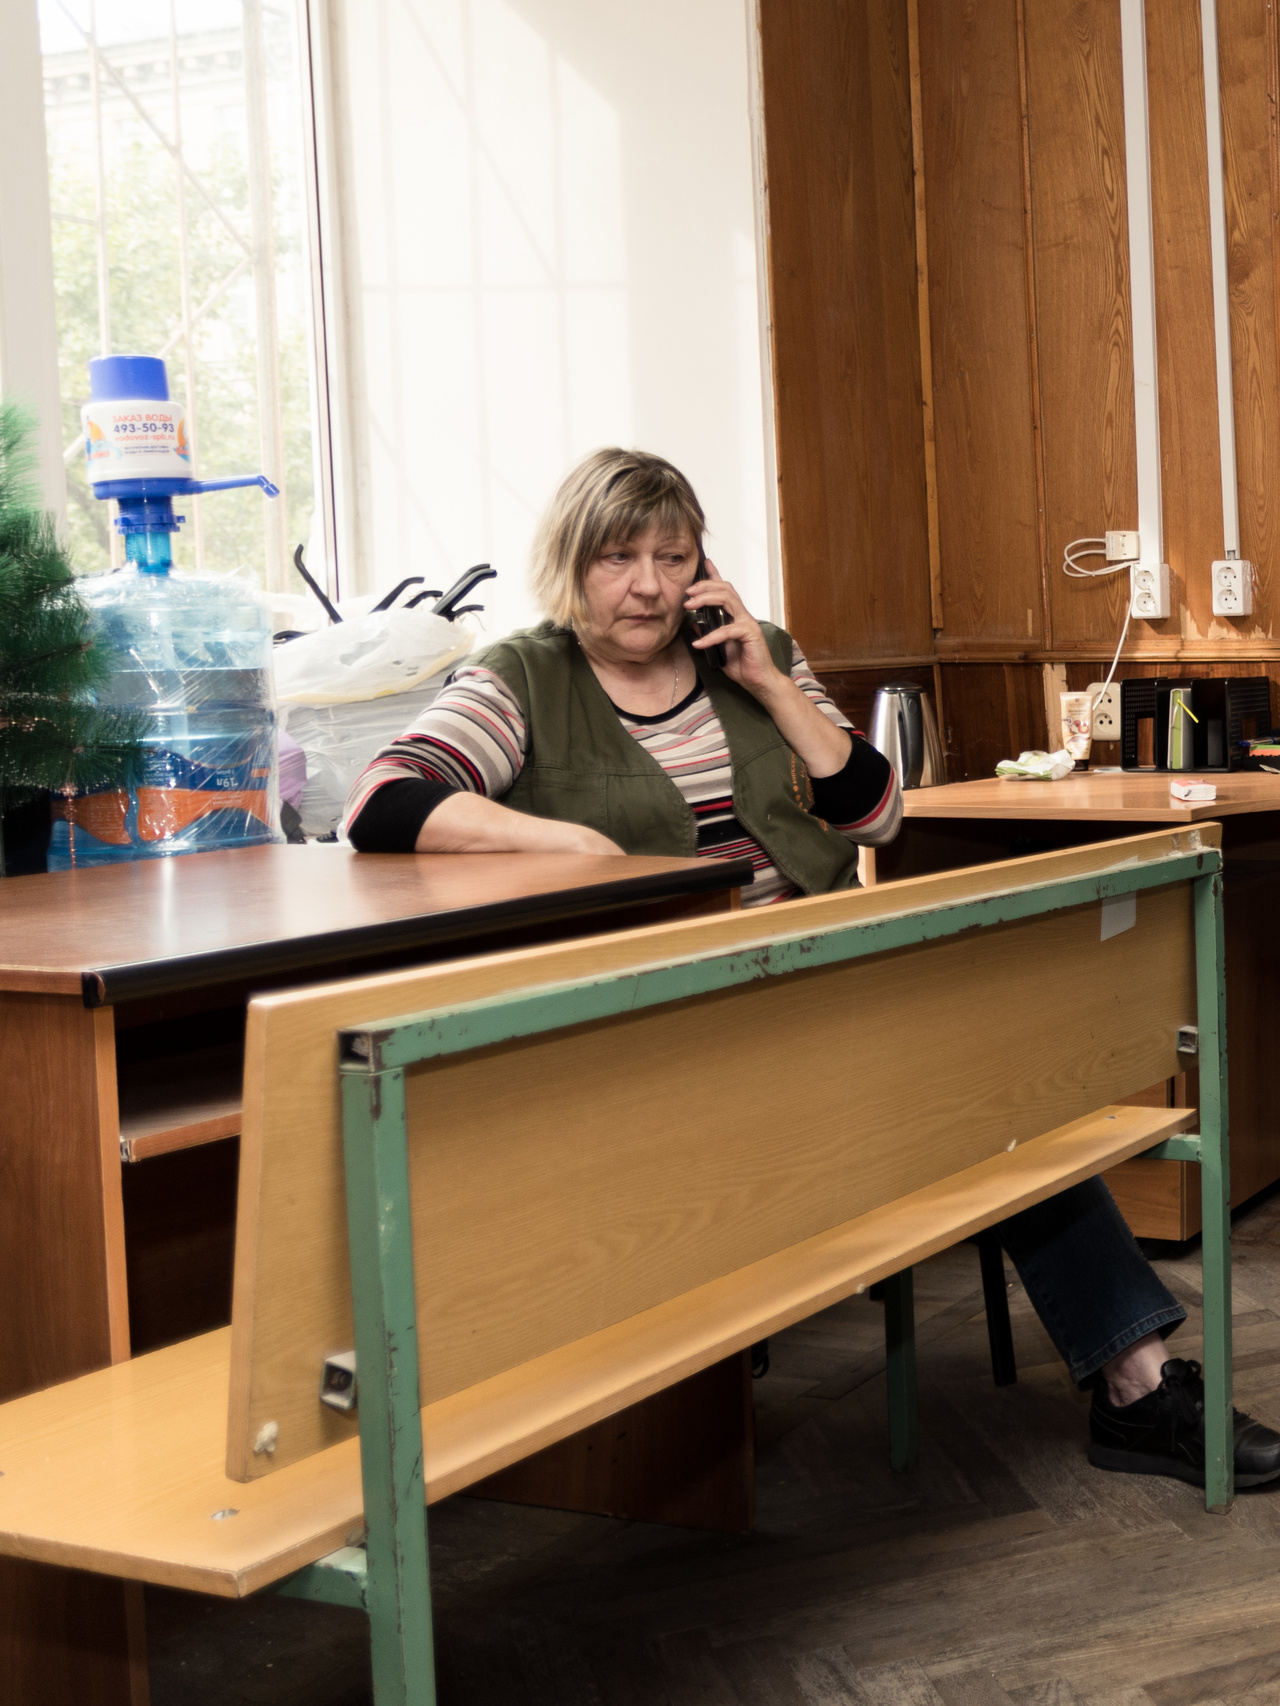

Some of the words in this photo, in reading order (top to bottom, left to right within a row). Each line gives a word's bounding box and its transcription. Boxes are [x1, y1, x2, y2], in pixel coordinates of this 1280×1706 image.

[112, 414, 142, 423] ЗАКАЗ
[145, 414, 172, 422] ВОДЫ
[114, 423, 174, 433] 493-50-93
